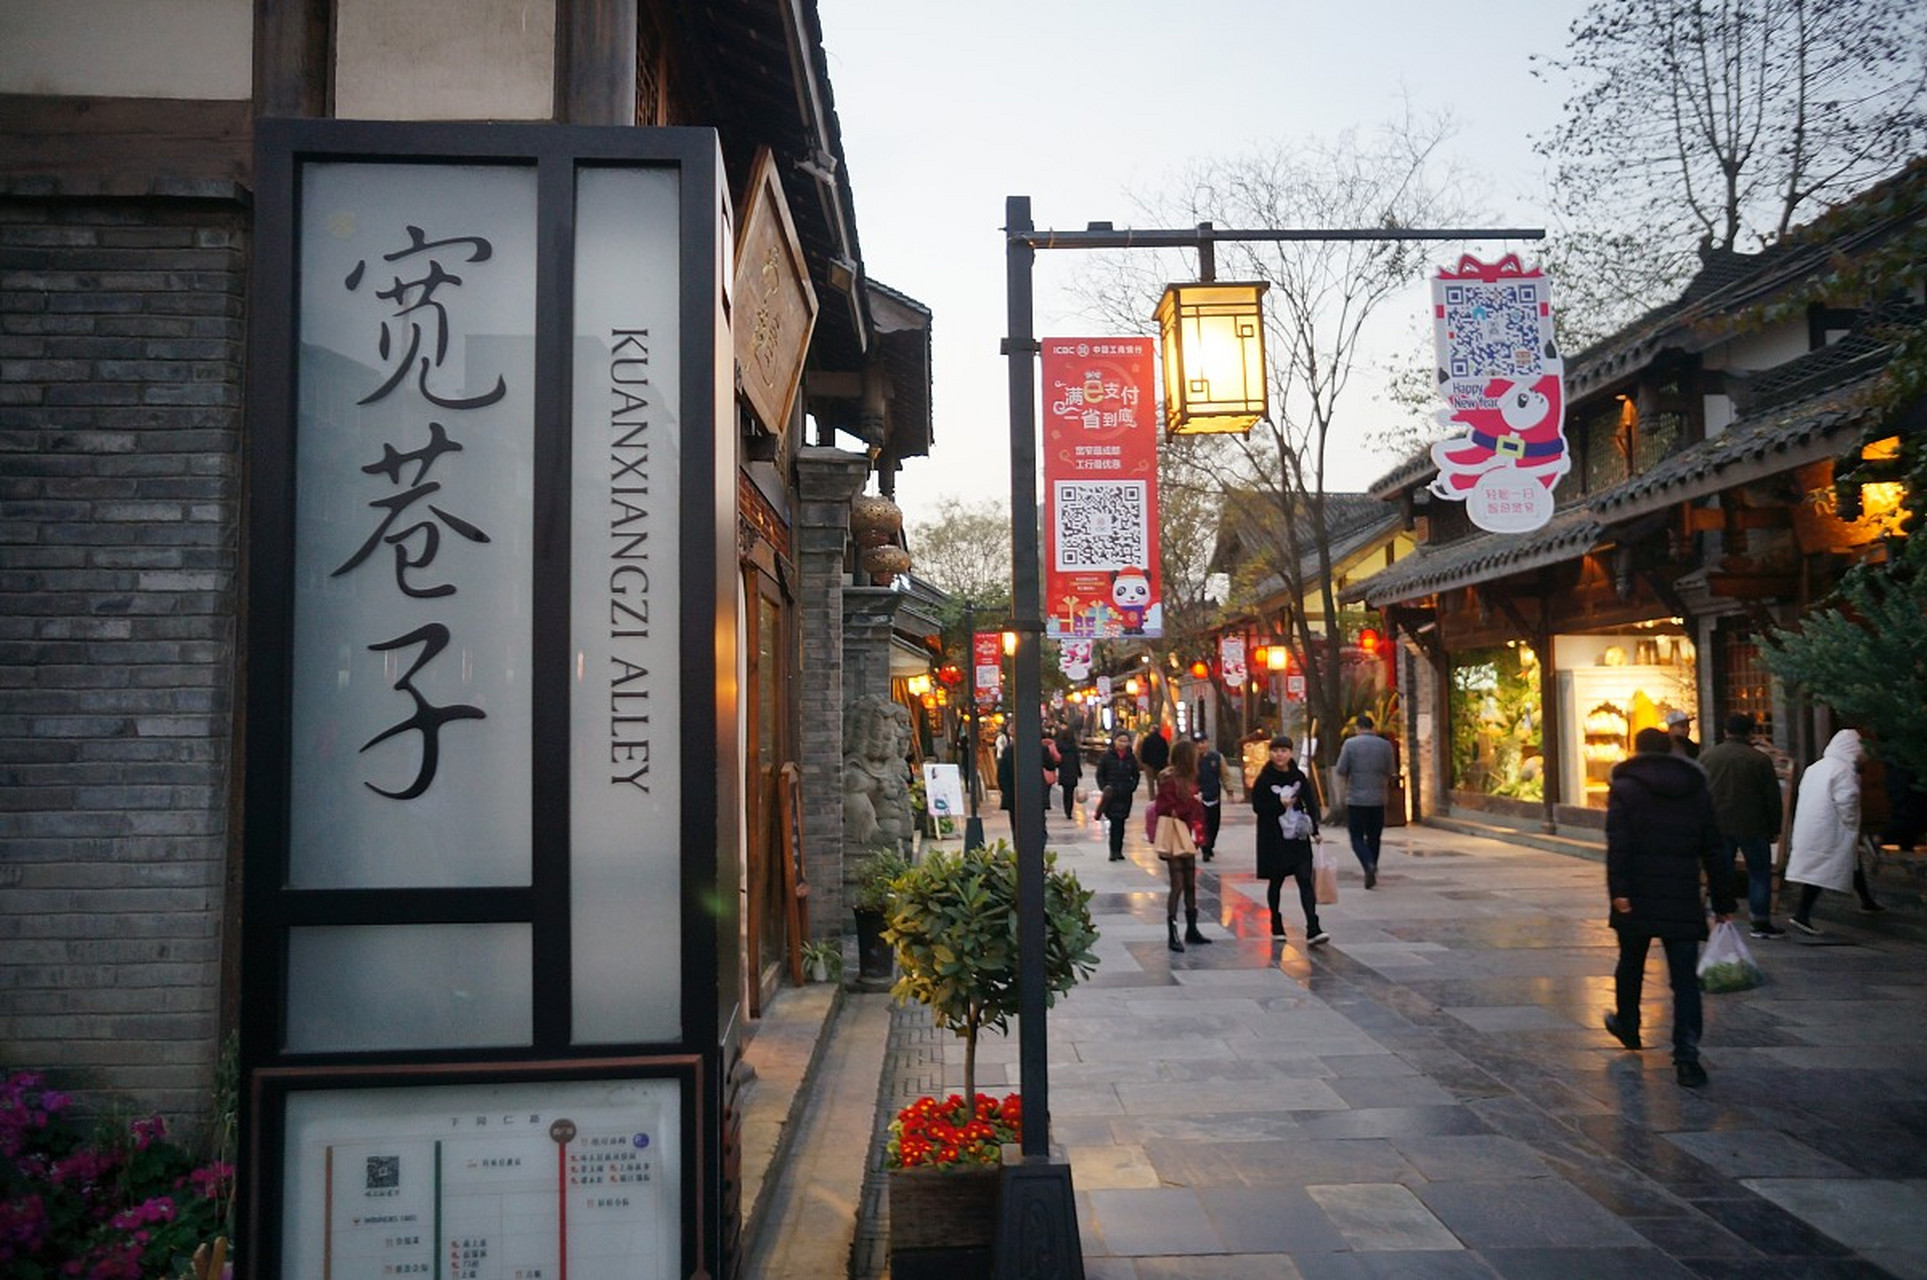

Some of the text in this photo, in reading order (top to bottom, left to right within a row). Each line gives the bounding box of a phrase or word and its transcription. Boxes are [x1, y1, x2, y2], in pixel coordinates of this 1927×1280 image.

[1453, 382, 1483, 396] Happy
[1454, 395, 1499, 409] New Year
[330, 225, 507, 801] 宽巷子
[610, 328, 650, 794] KUANXIANGZI ALLEY
